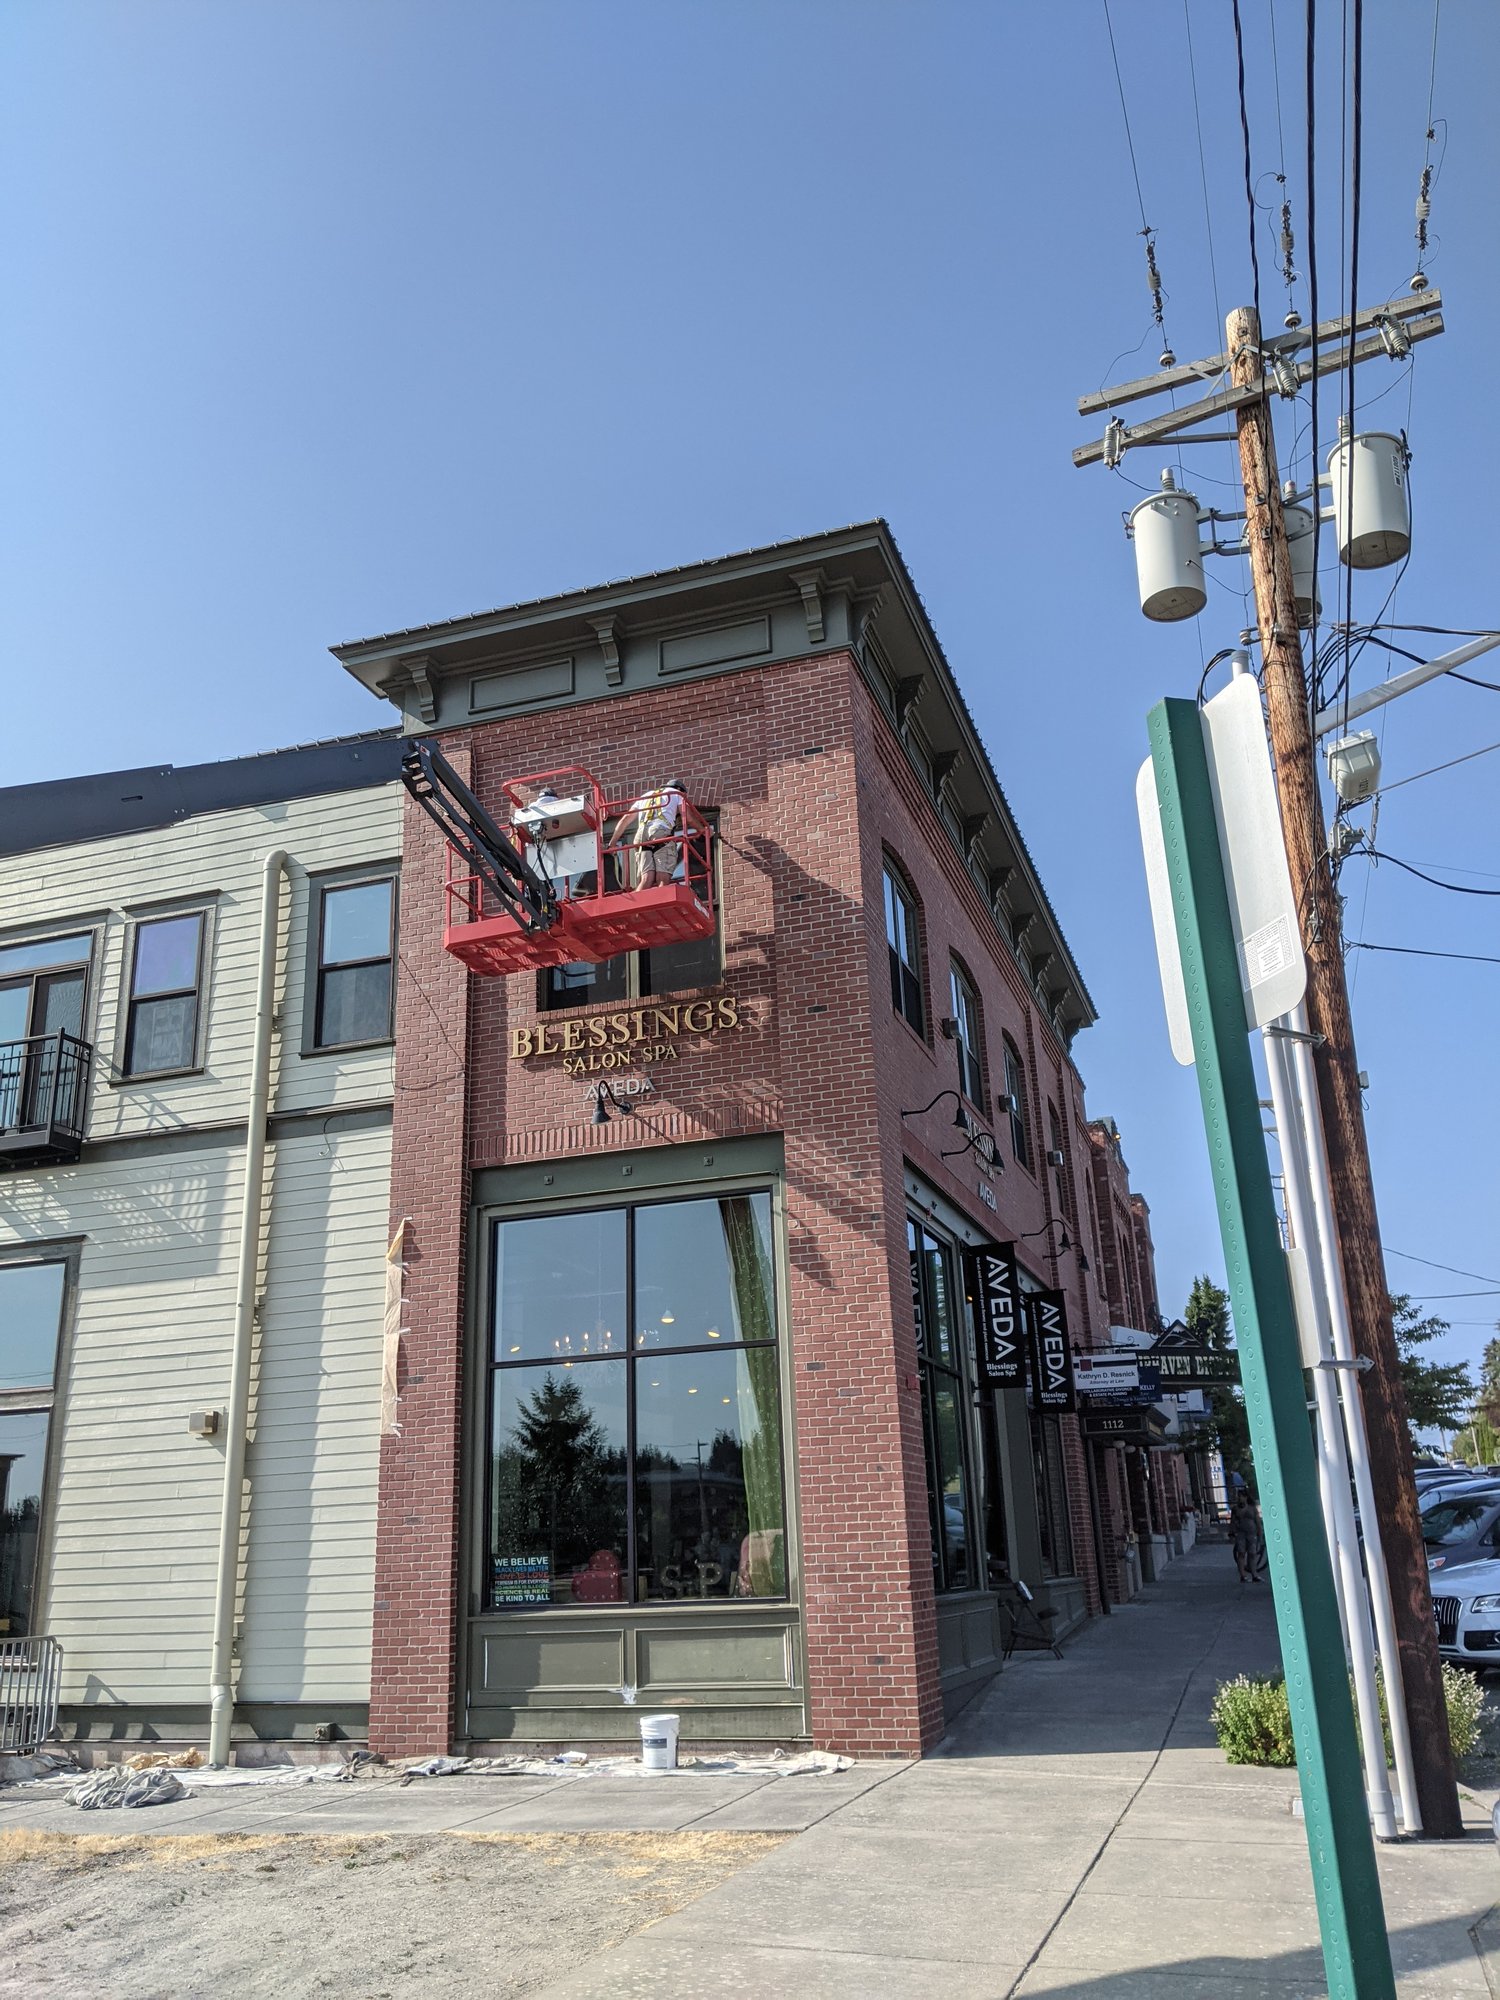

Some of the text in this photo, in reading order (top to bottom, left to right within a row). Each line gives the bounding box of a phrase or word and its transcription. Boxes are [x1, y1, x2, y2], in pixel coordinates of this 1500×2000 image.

[510, 997, 738, 1059] BLESSINGS
[562, 1044, 679, 1074] SALON SPA
[585, 1077, 657, 1101] AVEDA
[986, 1255, 1017, 1360] AVEDA
[1040, 1301, 1067, 1390] AVEDA
[986, 1362, 1018, 1372] Blessings
[1102, 1420, 1124, 1429] 1112
[495, 1557, 549, 1567] WE BELIEVE
